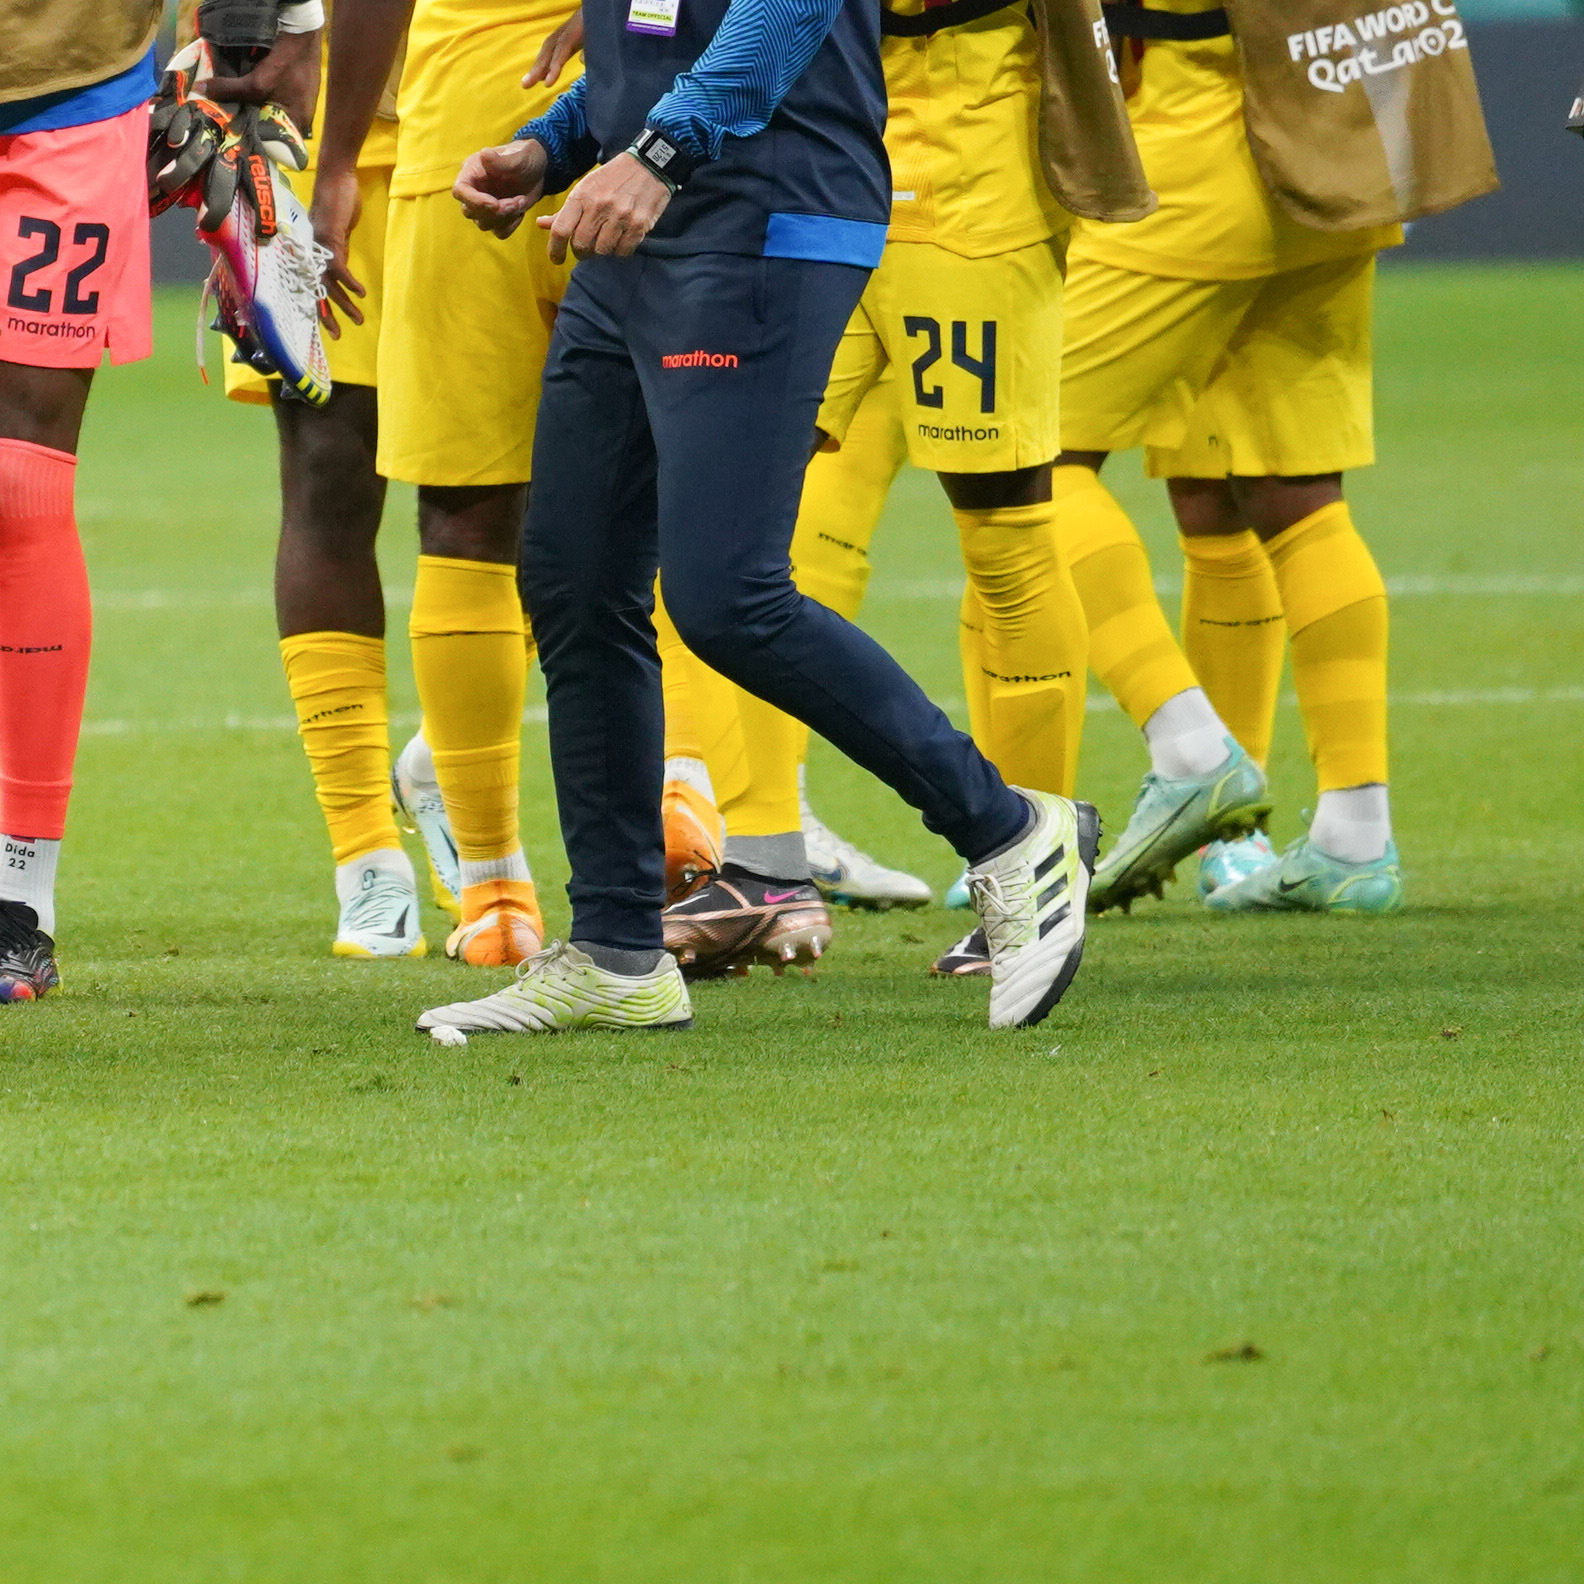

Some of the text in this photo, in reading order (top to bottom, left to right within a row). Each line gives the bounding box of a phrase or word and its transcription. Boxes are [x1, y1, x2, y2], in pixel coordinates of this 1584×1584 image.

[1286, 22, 1359, 63] FIFA
[7, 214, 111, 315] 22
[7, 317, 97, 339] marathon
[661, 349, 739, 369] marathon
[903, 315, 997, 414] 24
[917, 423, 1000, 442] marathon
[4, 842, 36, 858] Dida
[7, 857, 26, 871] 22
